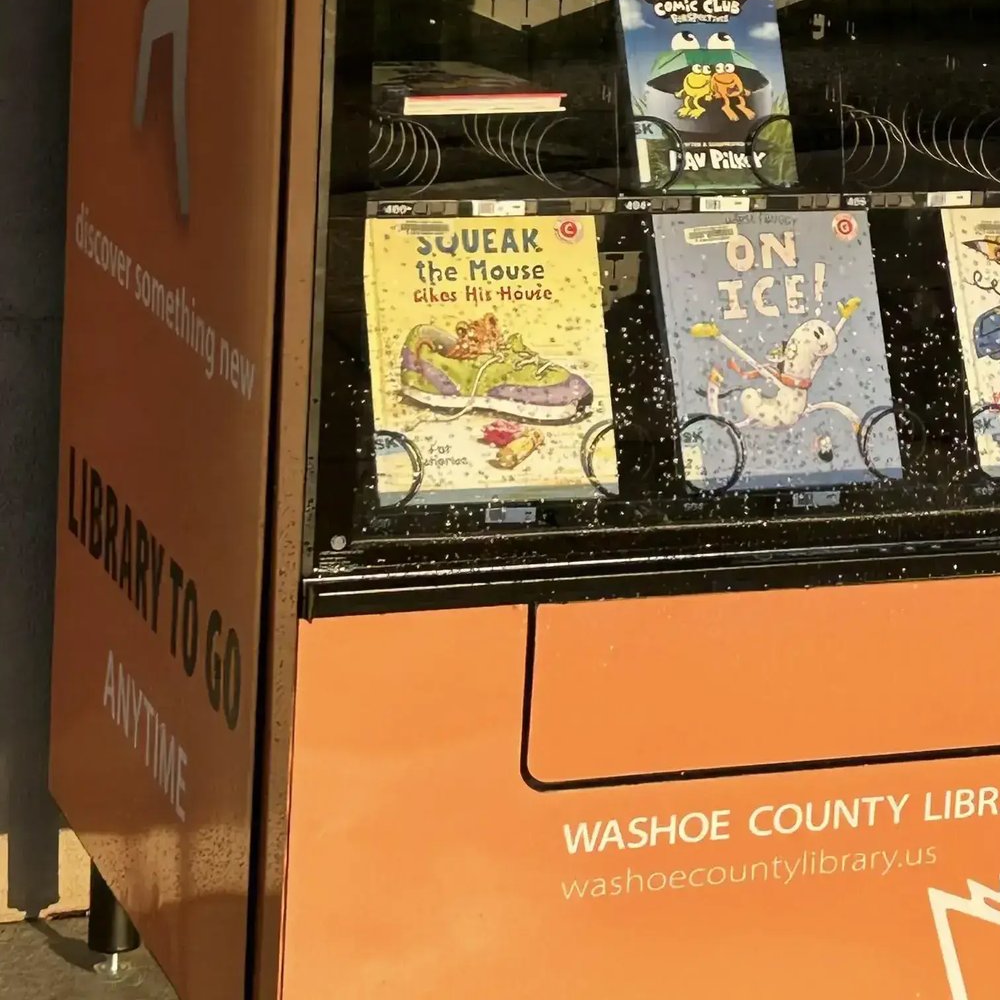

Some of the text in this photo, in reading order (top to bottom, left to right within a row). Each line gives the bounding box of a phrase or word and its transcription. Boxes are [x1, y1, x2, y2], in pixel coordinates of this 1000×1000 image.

[416, 228, 543, 256] SQUEAK
[726, 231, 797, 272] ON
[75, 202, 256, 401] discover something new
[416, 260, 545, 285] the Mouse
[717, 262, 826, 321] ICE!
[67, 446, 242, 731] LIBRARY TO GO
[103, 649, 188, 823] ANYTIME
[562, 809, 731, 856] WASHOE
[748, 793, 911, 838] COUNTY
[561, 845, 938, 901] washoecountylibrary.us
